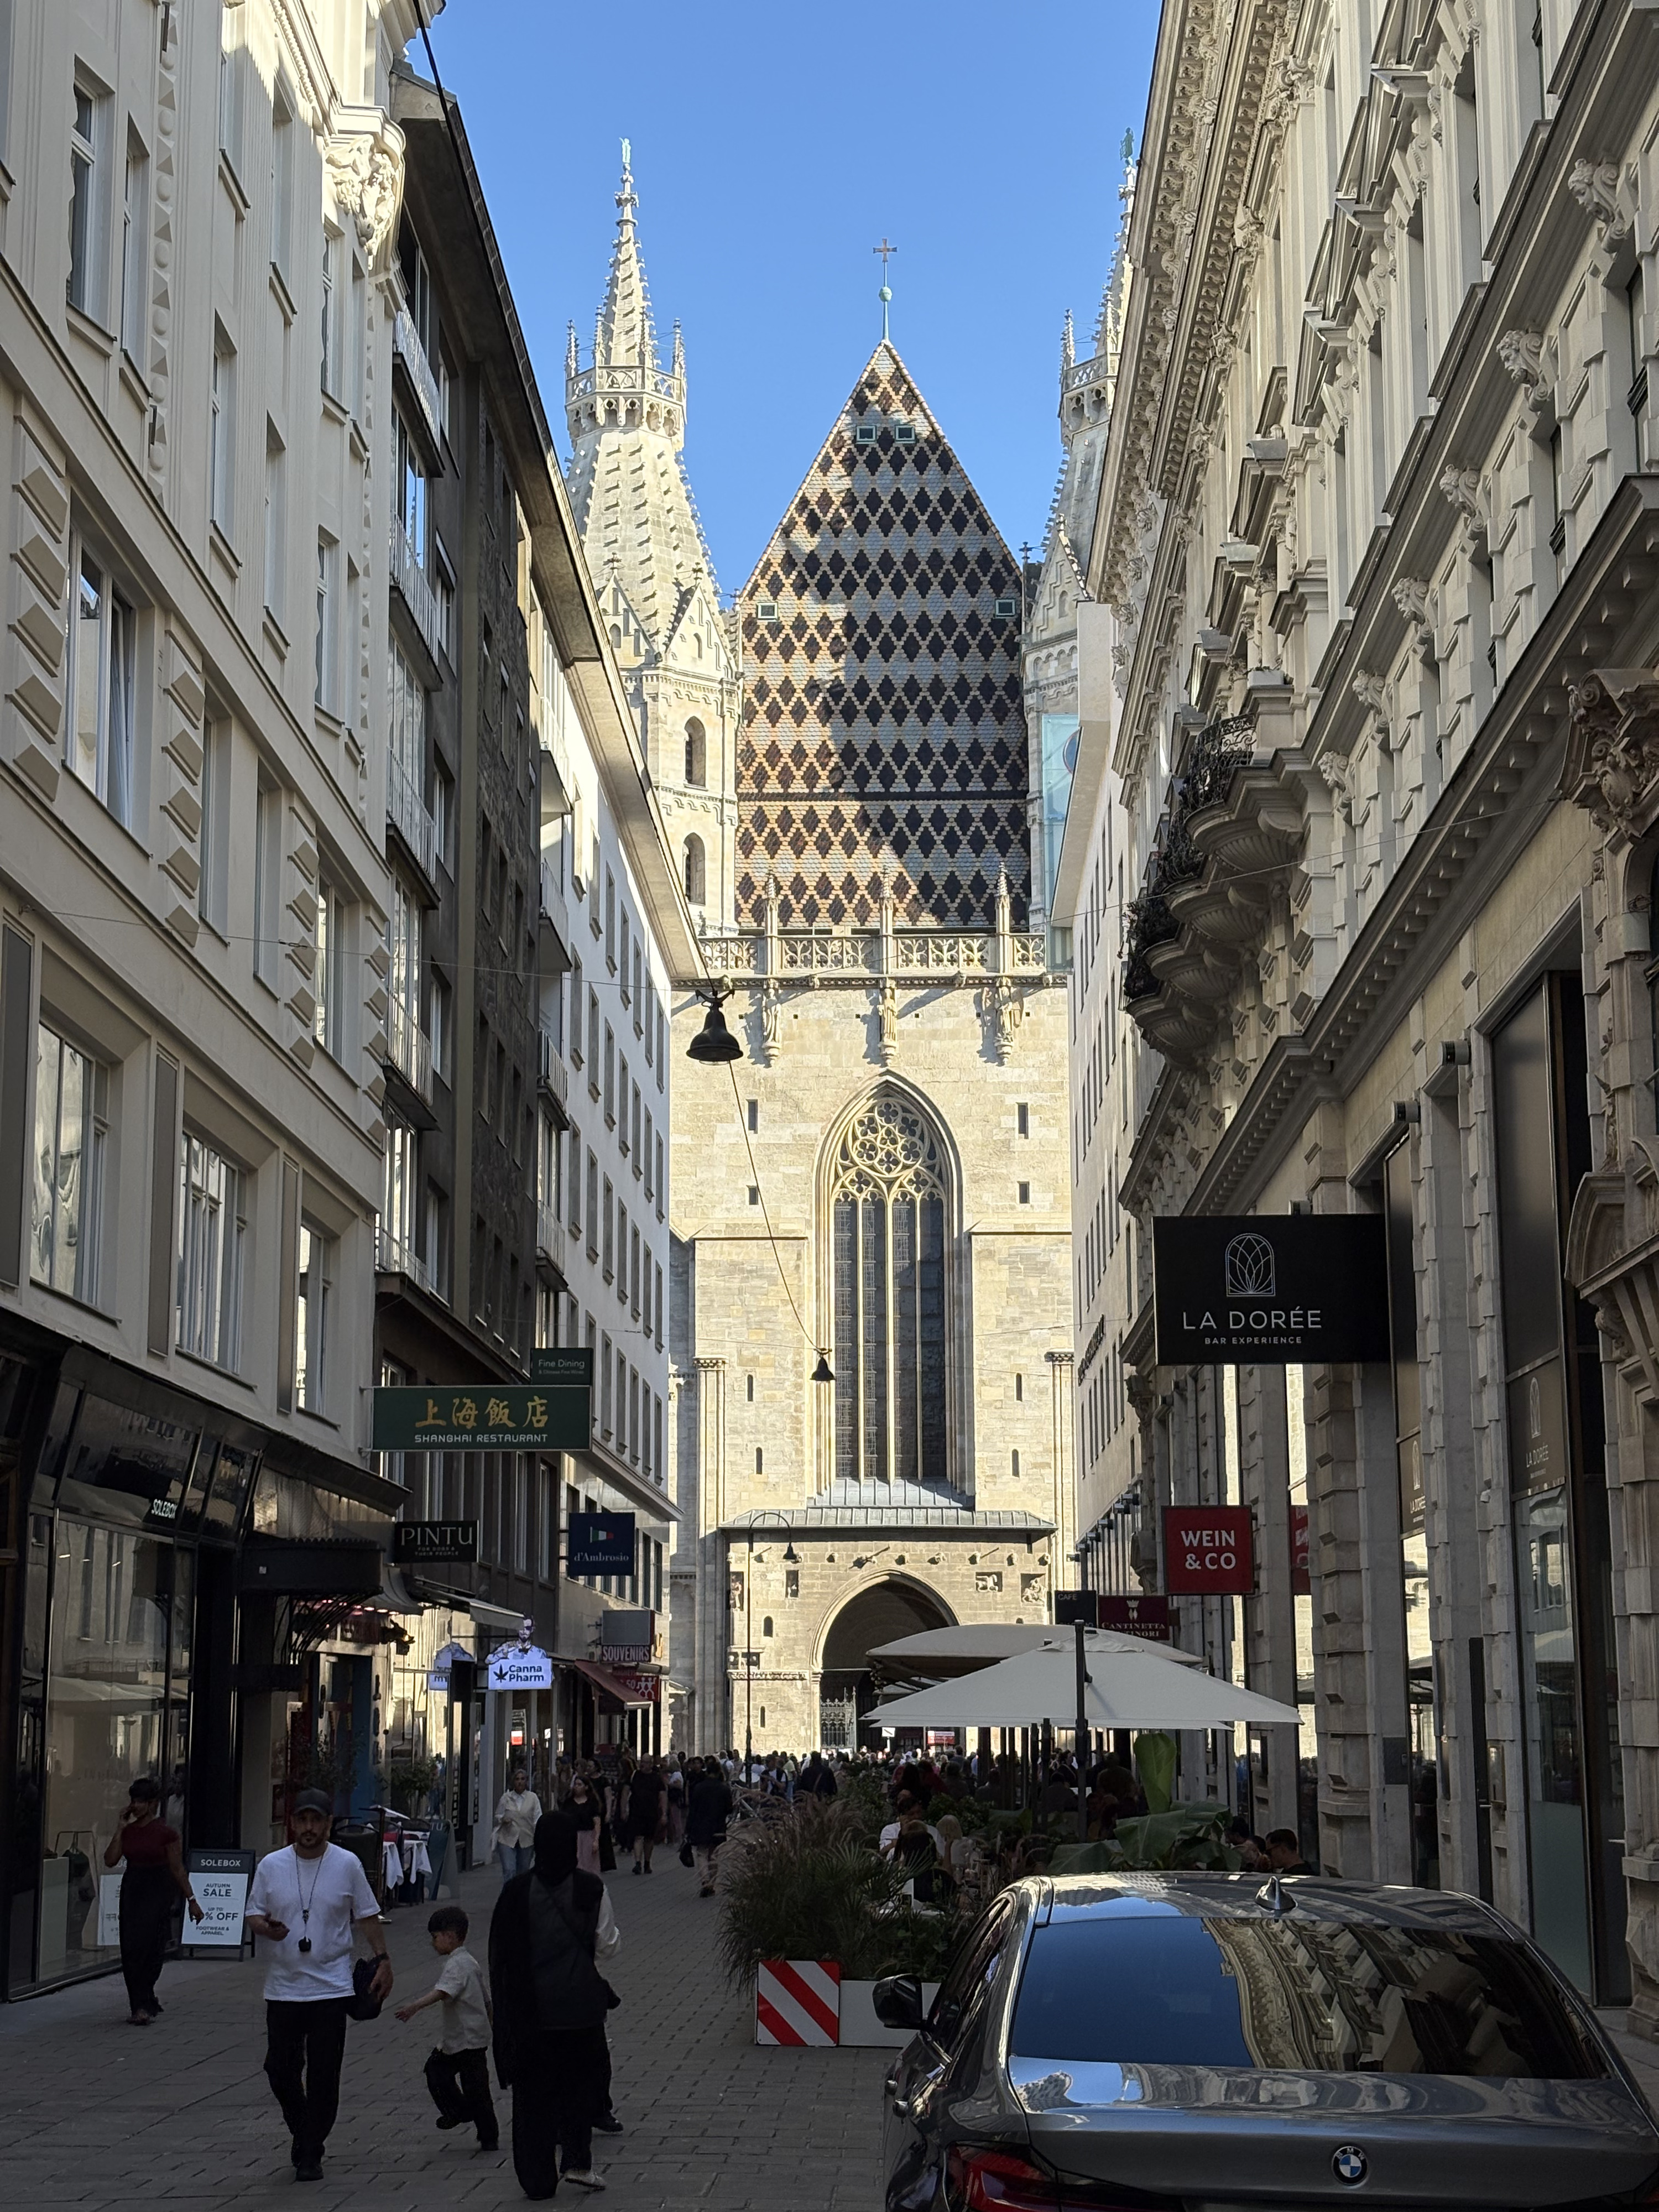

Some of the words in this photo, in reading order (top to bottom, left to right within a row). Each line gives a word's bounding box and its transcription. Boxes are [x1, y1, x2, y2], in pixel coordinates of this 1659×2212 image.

[1182, 1311, 1217, 1329] LA
[1229, 1306, 1322, 1329] DORÉE
[1232, 1336, 1302, 1344] EXPERIENCE
[538, 1359, 555, 1367] Fine
[557, 1359, 585, 1369] Dining
[415, 1395, 549, 1430] 上海飯店
[414, 1433, 472, 1443] SHANGHAI
[476, 1433, 549, 1443] RESTAURANT
[151, 1499, 178, 1519] SOLEBOX
[400, 1526, 473, 1546] PINTU
[1180, 1530, 1235, 1547] WEIN
[602, 1646, 650, 1662] SOUVENIRS
[508, 1665, 542, 1673] Canna
[508, 1673, 544, 1682] Pharm
[200, 1859, 241, 1867] SOLEBOX
[203, 1888, 232, 1897] SALE
[216, 1912, 239, 1921] OFF
[1335, 2148, 1365, 2161] BMW
